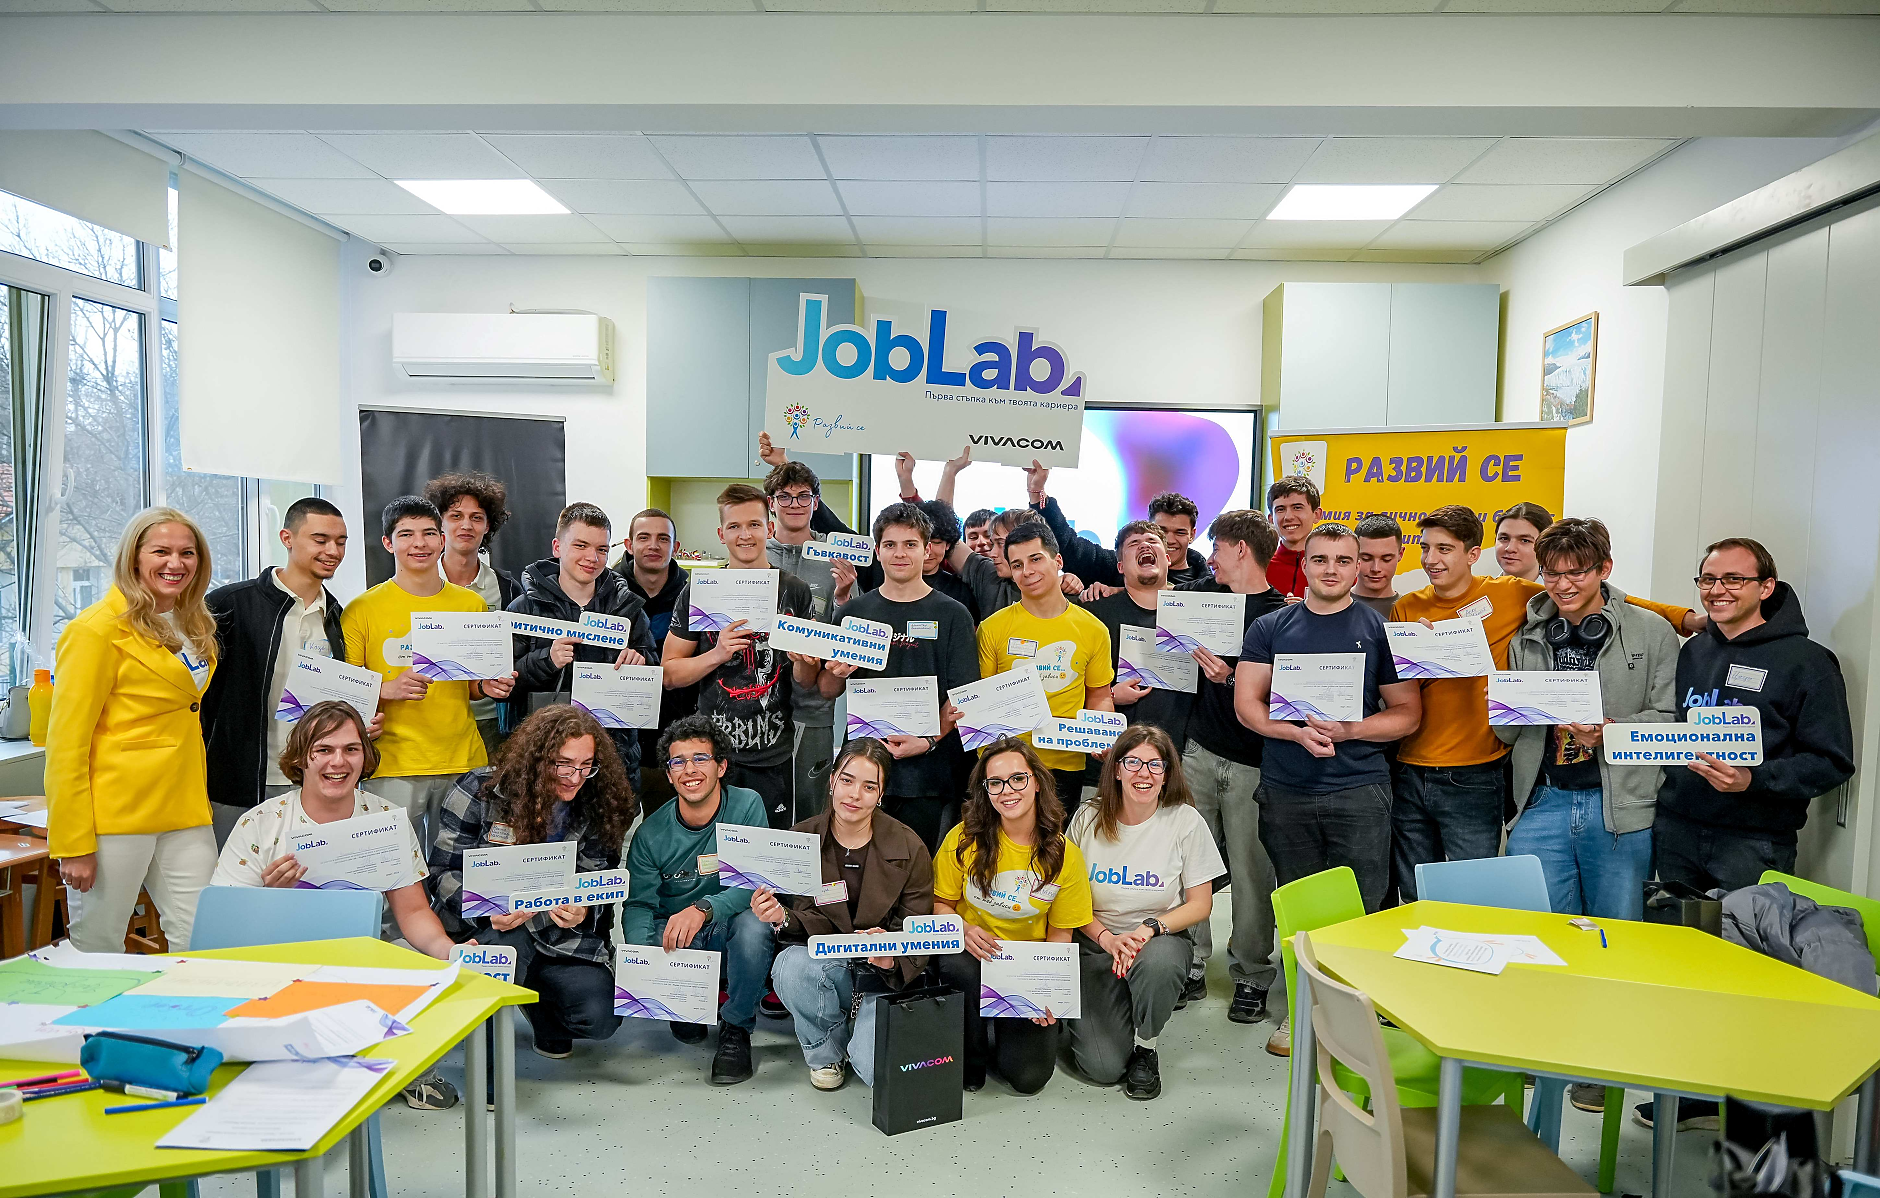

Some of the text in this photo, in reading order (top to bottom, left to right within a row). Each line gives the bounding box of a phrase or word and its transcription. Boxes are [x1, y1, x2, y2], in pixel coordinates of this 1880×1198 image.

[925, 391, 1079, 412] Първа стъпка към твоята кариера
[813, 414, 854, 438] Развий
[968, 434, 1065, 451] VIVACOM
[1344, 445, 1524, 484] РАЗВИЙ СЕ
[1321, 510, 1352, 521] мия
[806, 546, 870, 562] Гъвкавост
[511, 620, 625, 645] итично мислене
[777, 619, 887, 652] Комуникативни
[1434, 627, 1474, 637] СЕРТИФИКАТ
[831, 648, 884, 666] умения
[338, 674, 373, 688] СЕРТИФИКАТ
[995, 676, 1031, 692] СЕРТИФИКАТ
[1037, 736, 1113, 749] на пробле
[1630, 730, 1756, 743] Емоционална
[351, 824, 397, 839] СЕРТИФИКАТ
[769, 841, 811, 850] СЕРТИФИКАТ
[522, 854, 566, 864] СЕРТИФИКАТ
[514, 890, 624, 910] Работа в екип
[815, 939, 960, 956] Дигитални умения
[669, 961, 711, 970] СЕРТИФИКАТ
[899, 1055, 954, 1072] VIVACOM
